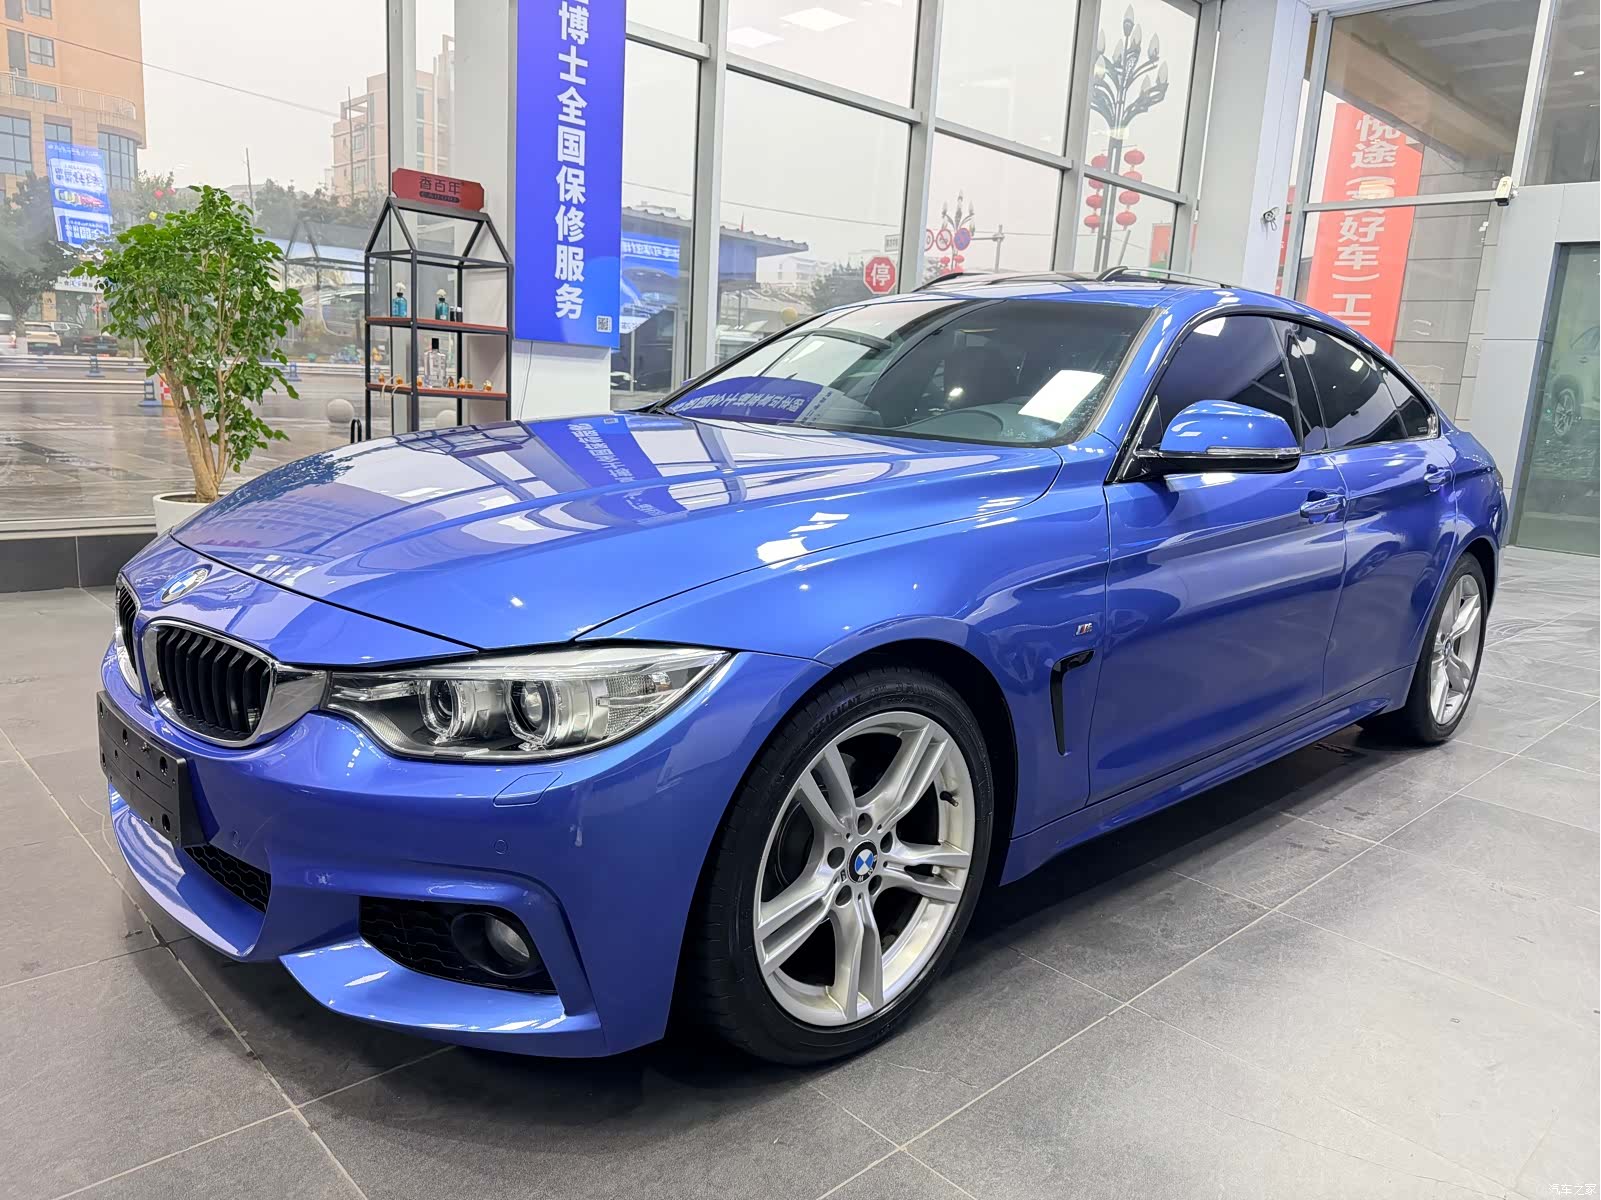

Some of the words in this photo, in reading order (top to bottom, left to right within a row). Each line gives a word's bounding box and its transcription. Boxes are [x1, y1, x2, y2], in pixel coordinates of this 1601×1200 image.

[555, 0, 589, 320] 博士全国保修服务
[419, 176, 461, 195] 香百年
[870, 263, 891, 286] 停
